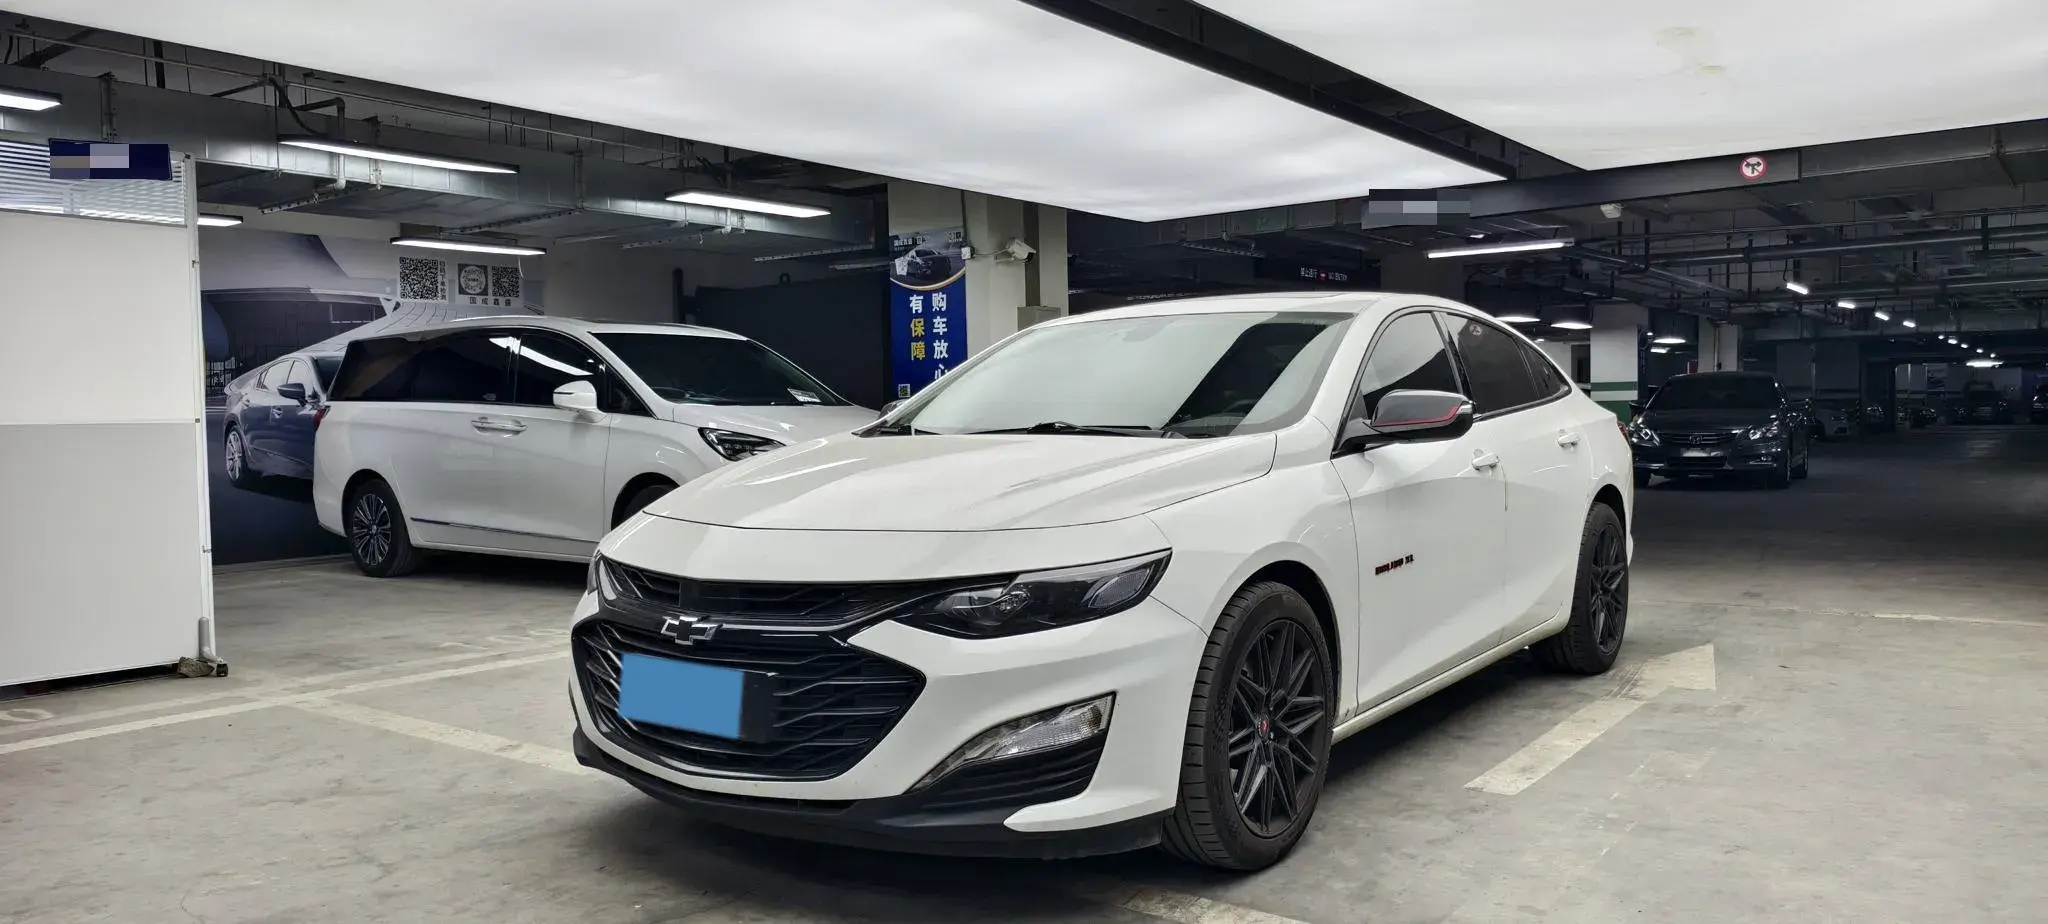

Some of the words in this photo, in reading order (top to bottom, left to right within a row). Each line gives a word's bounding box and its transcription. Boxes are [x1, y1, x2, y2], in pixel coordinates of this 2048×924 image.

[909, 294, 926, 361] 有保障
[932, 292, 948, 381] 购车放心
